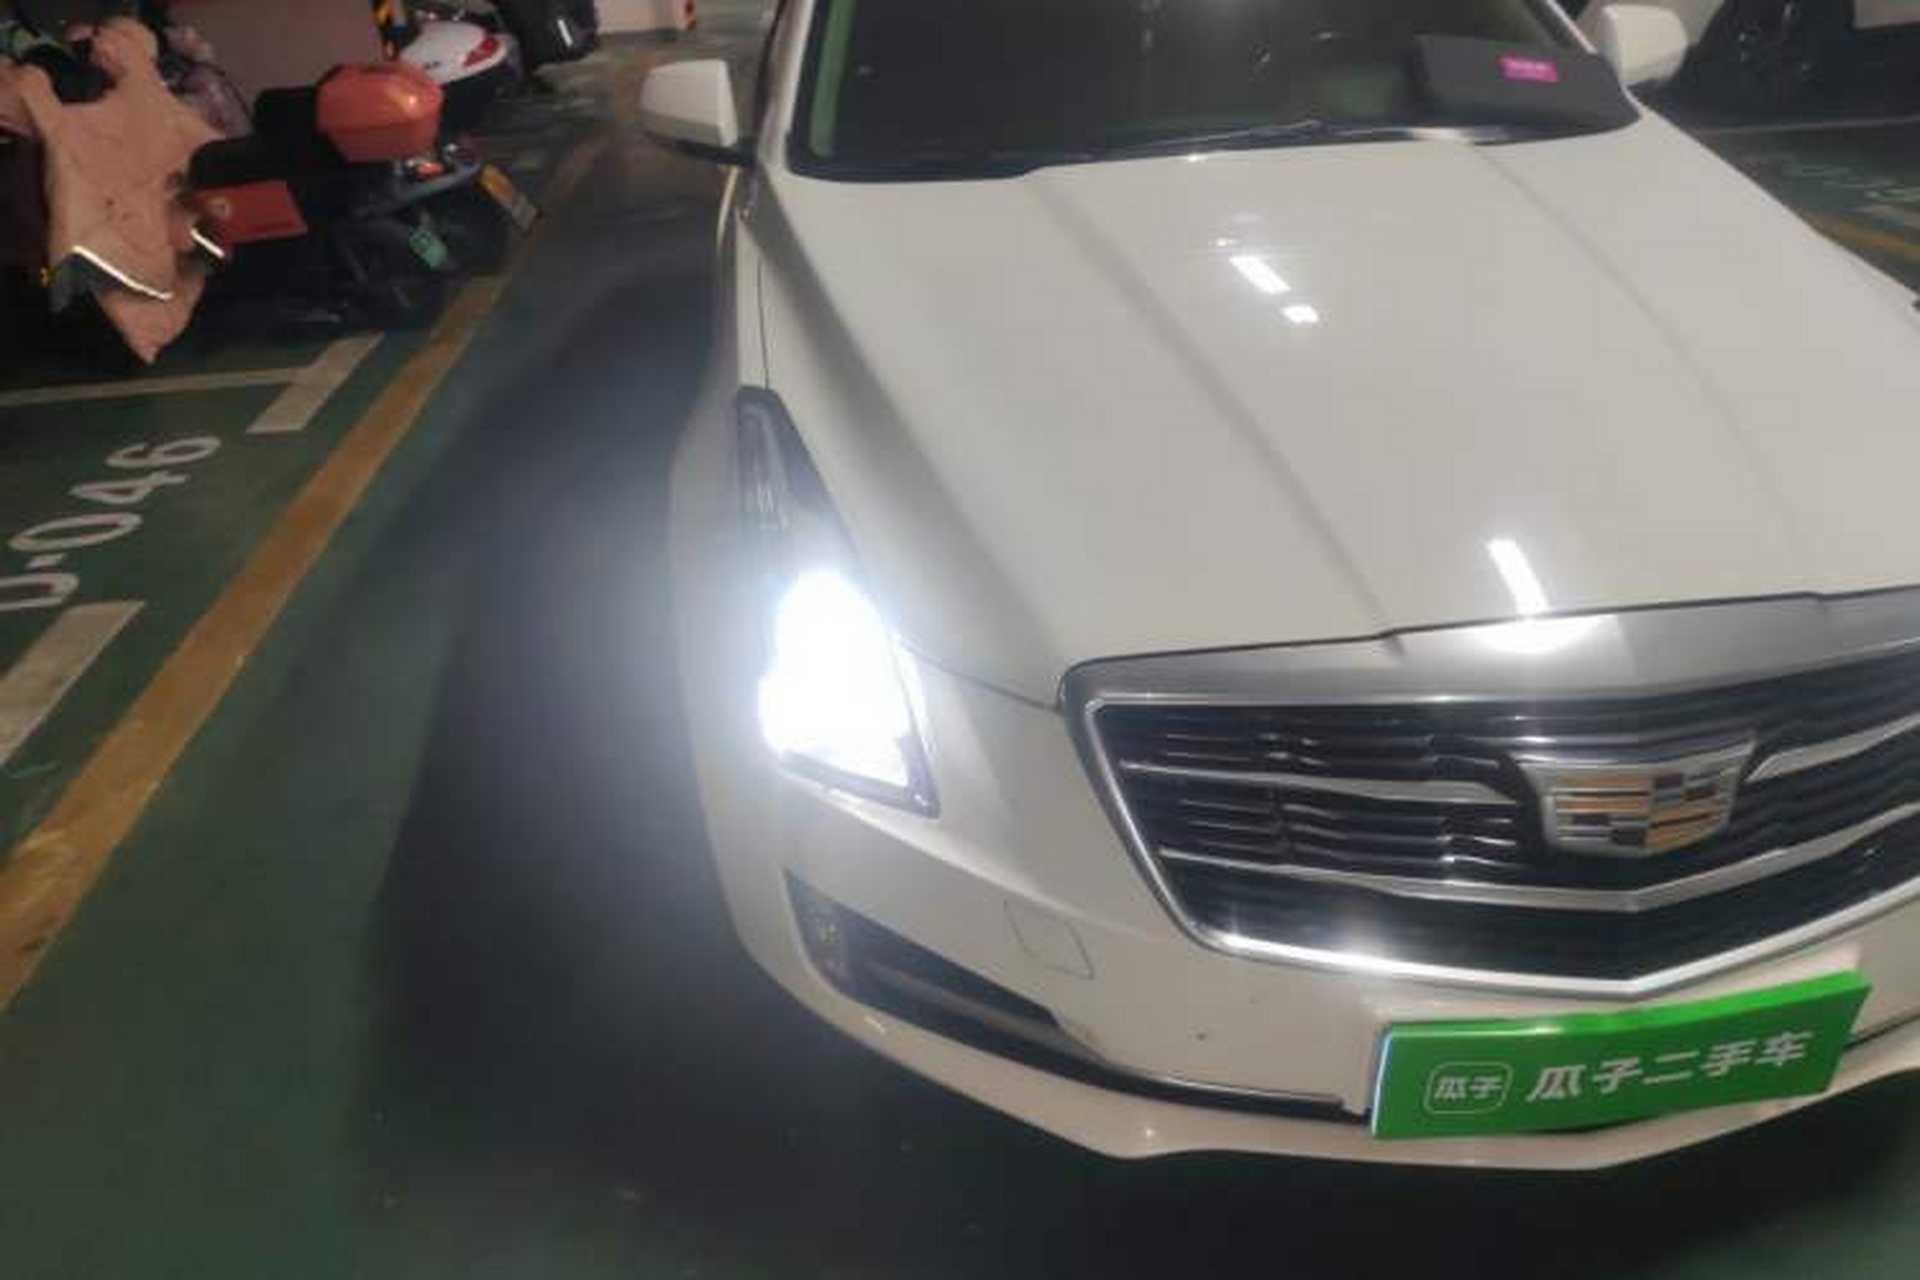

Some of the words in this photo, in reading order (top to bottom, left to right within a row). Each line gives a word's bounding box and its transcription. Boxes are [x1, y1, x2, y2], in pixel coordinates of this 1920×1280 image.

[1433, 1075, 1504, 1101] 瓜子
[1525, 1031, 1813, 1102] 瓜子二手车
